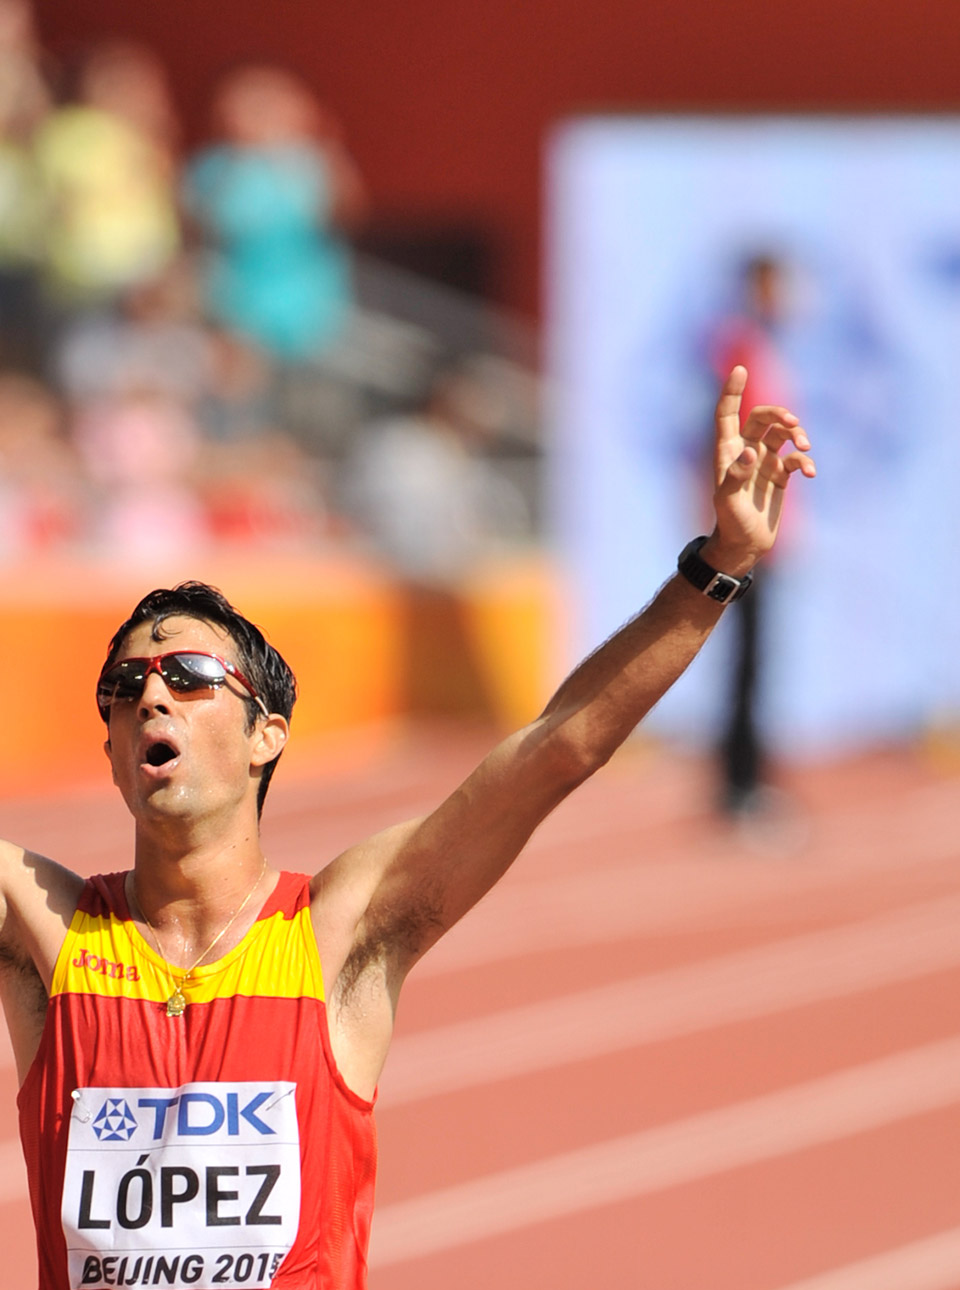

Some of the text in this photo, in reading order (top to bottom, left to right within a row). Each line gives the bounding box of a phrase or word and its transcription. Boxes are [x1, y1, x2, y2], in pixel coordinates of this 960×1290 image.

[72, 948, 140, 982] Joma
[138, 1091, 277, 1141] TDK
[77, 1154, 282, 1230] LÓPEZ
[82, 1254, 205, 1286] BEIJING
